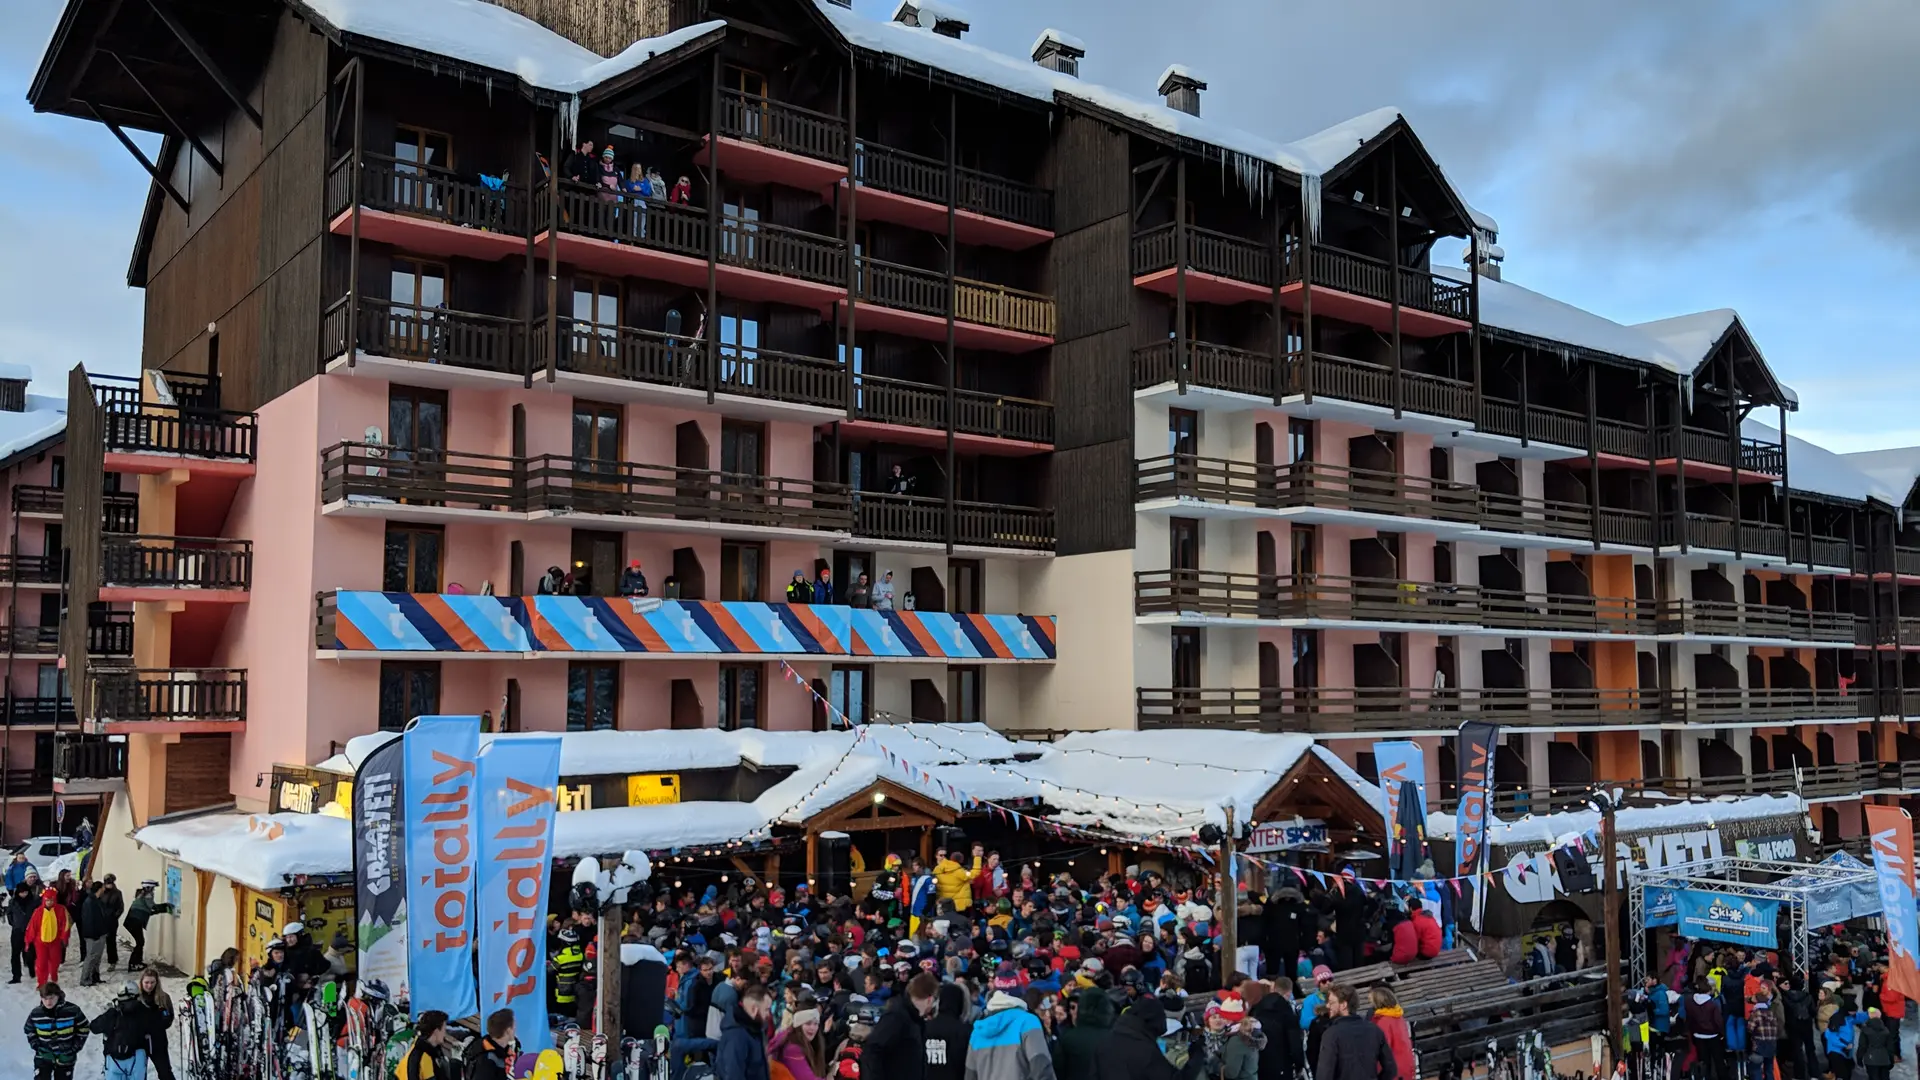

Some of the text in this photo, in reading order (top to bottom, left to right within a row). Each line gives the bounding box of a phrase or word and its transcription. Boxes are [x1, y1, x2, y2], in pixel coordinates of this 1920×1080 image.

[364, 773, 391, 825] YETI
[421, 750, 476, 952] totally
[1637, 829, 1726, 876] YETI
[1771, 839, 1796, 859] FOOD
[340, 897, 354, 906] SN
[494, 777, 556, 1005] totally
